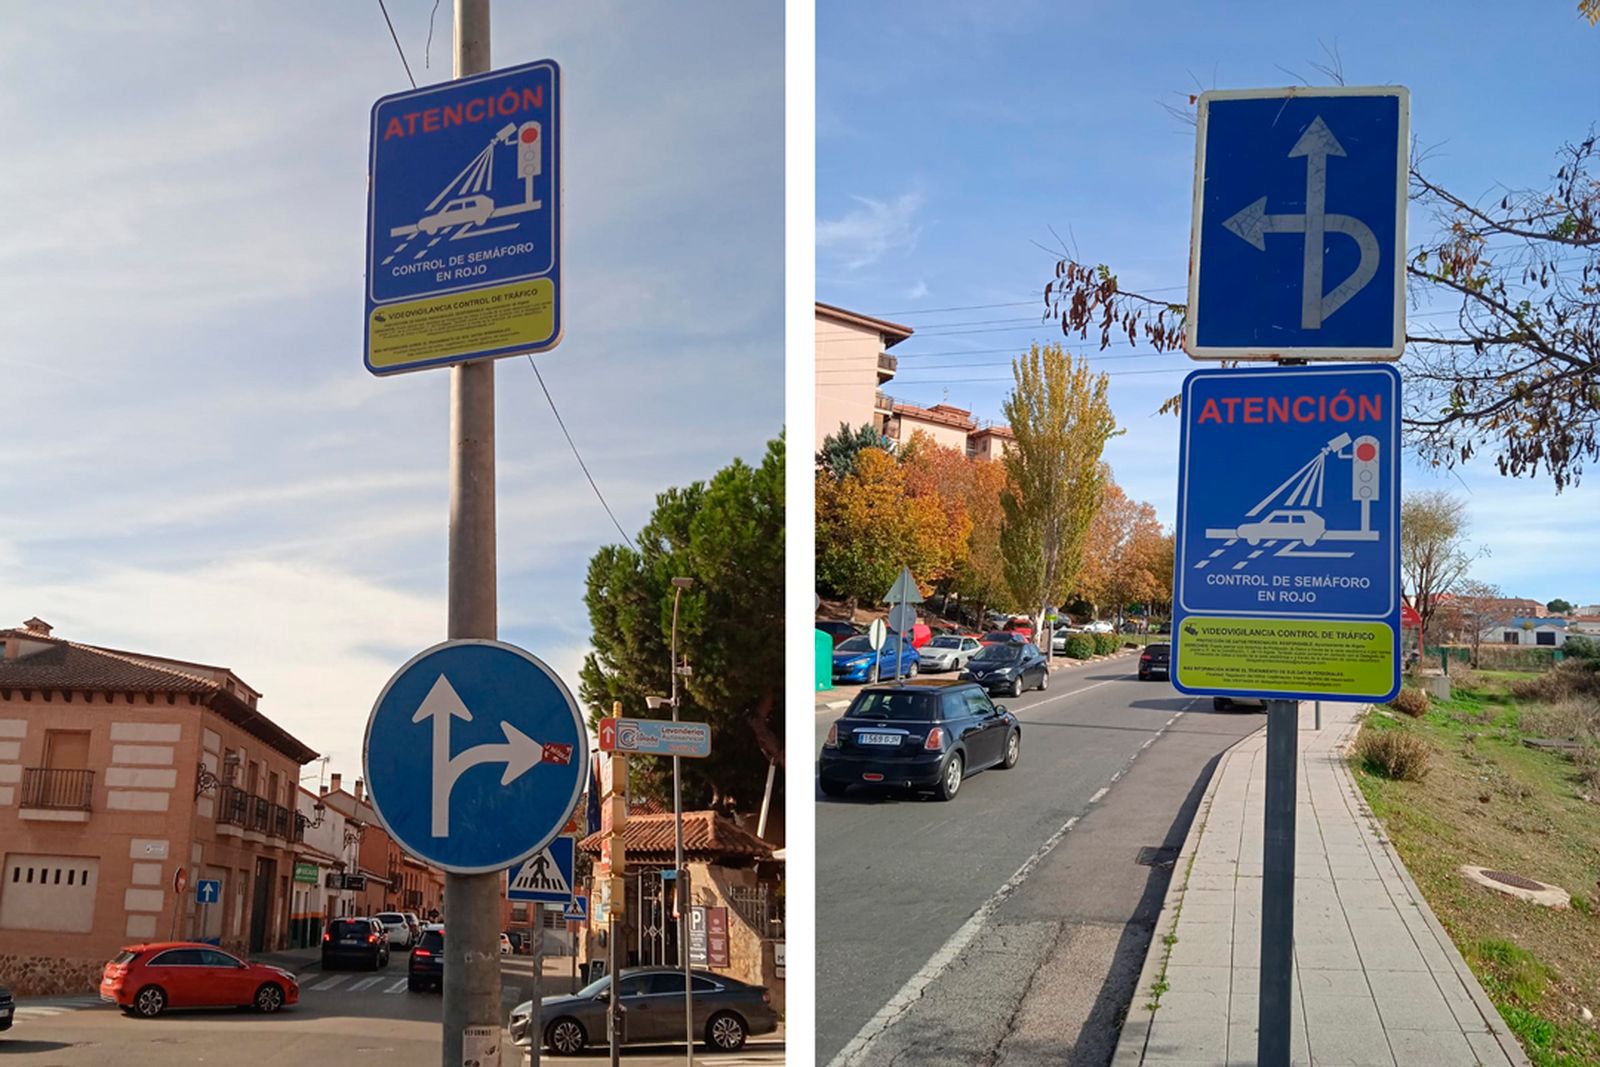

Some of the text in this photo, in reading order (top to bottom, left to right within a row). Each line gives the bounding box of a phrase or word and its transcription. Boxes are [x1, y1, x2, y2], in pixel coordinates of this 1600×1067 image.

[384, 85, 543, 141] ATENCIÓN
[392, 242, 535, 277] CONTROL DE SEMÁFORO
[436, 264, 488, 282] EN ROJO
[388, 304, 452, 320] VIDEOVIGILANCIA
[453, 297, 490, 309] CONTROL
[492, 295, 503, 303] DE
[1197, 389, 1382, 424] ATENCIÓN
[1207, 573, 1370, 588] CONTROL DE SEMÁFORO
[1258, 591, 1316, 602] EN ROJO
[1201, 627, 1375, 640] VIDEOVIGILANCIA CONTROL DE TRÁFICO
[692, 911, 701, 930] P
